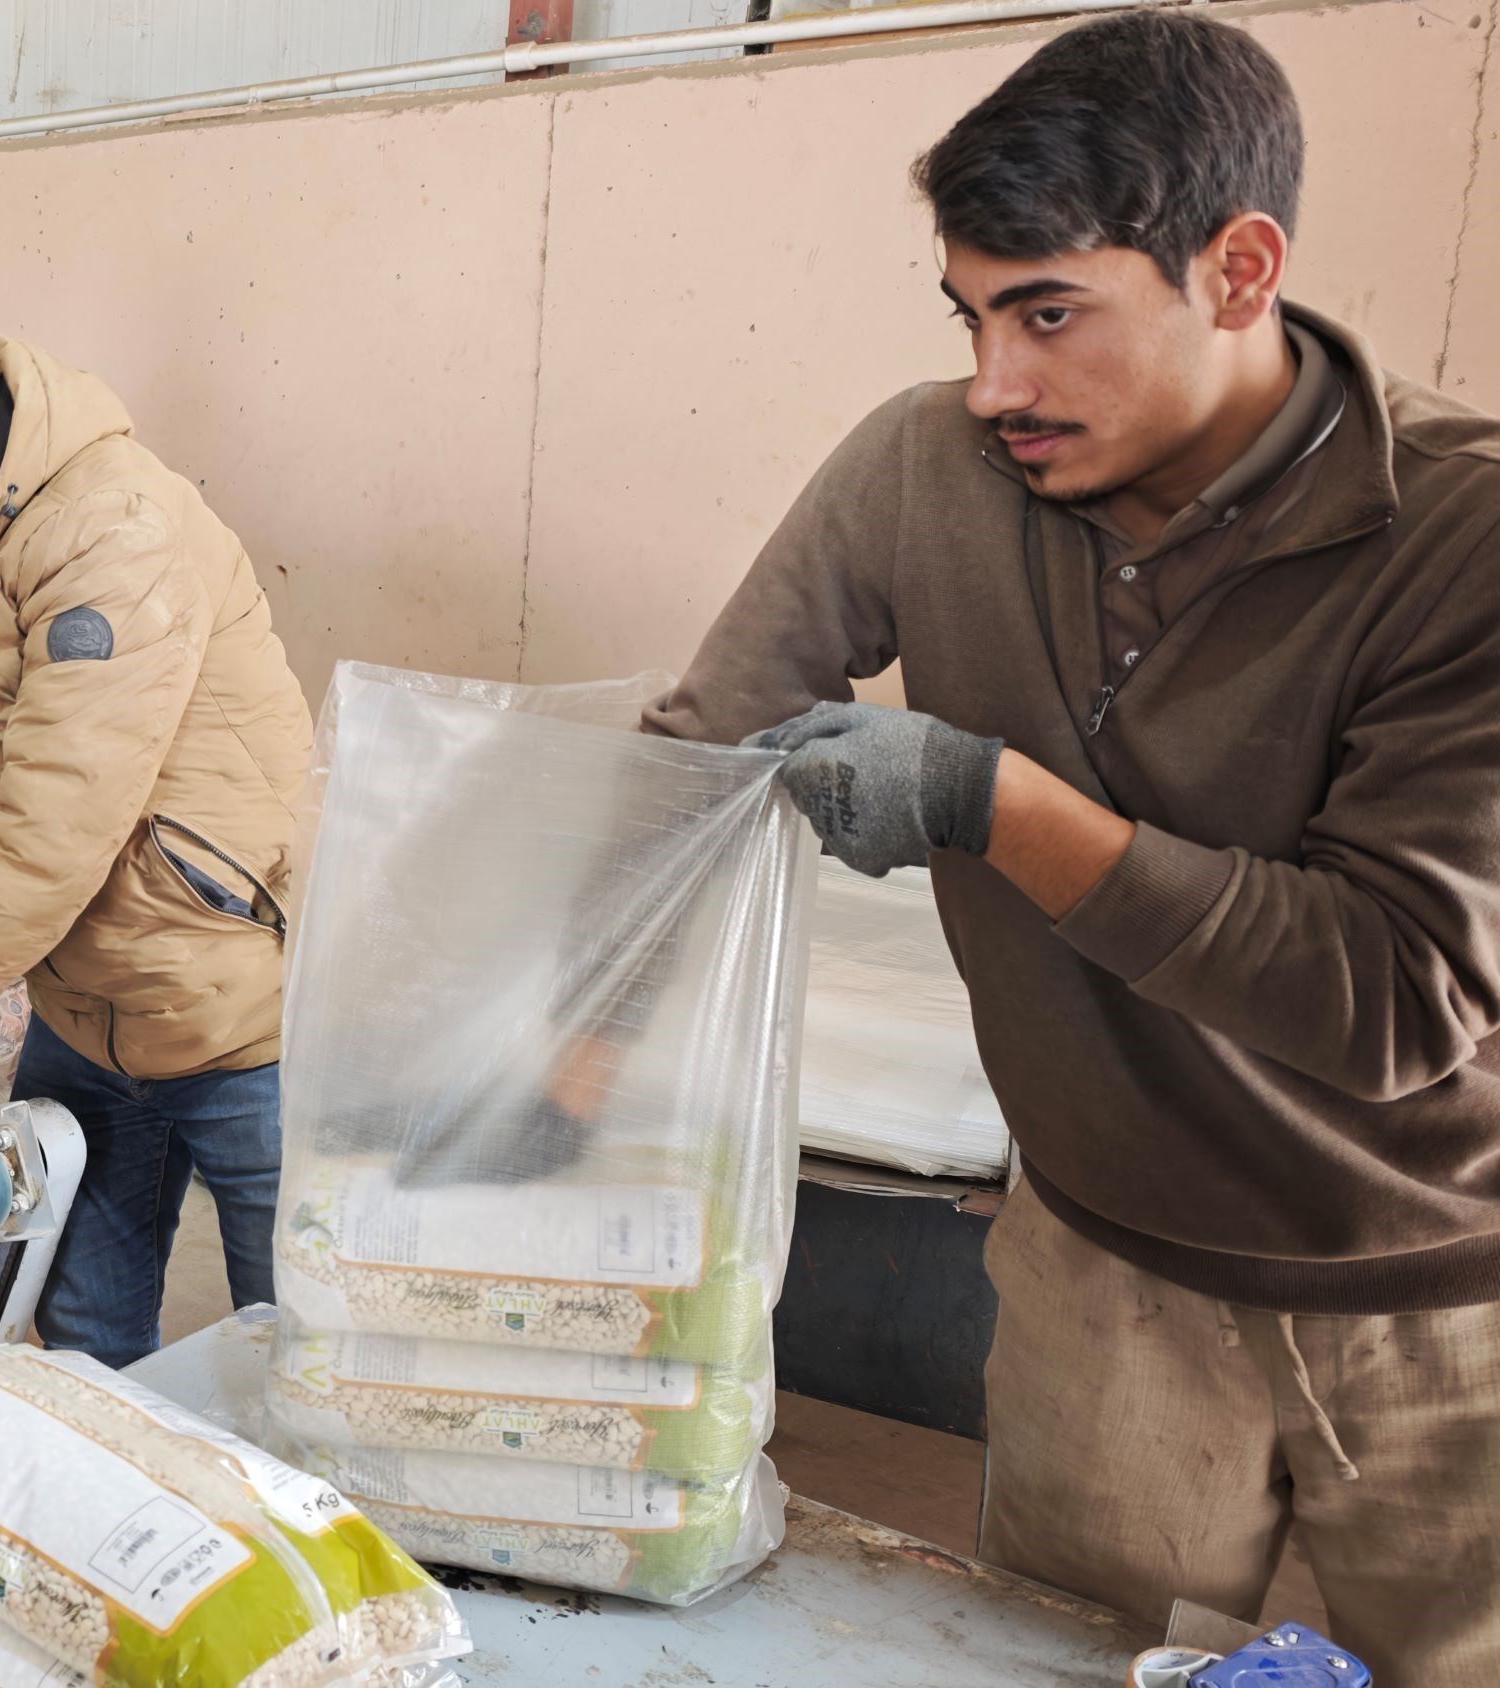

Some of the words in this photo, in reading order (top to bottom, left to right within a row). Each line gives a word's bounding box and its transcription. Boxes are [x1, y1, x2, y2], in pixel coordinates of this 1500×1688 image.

[485, 1296, 545, 1312] AHLAT
[482, 1414, 540, 1429] AHLAT
[315, 1493, 340, 1510] Kg
